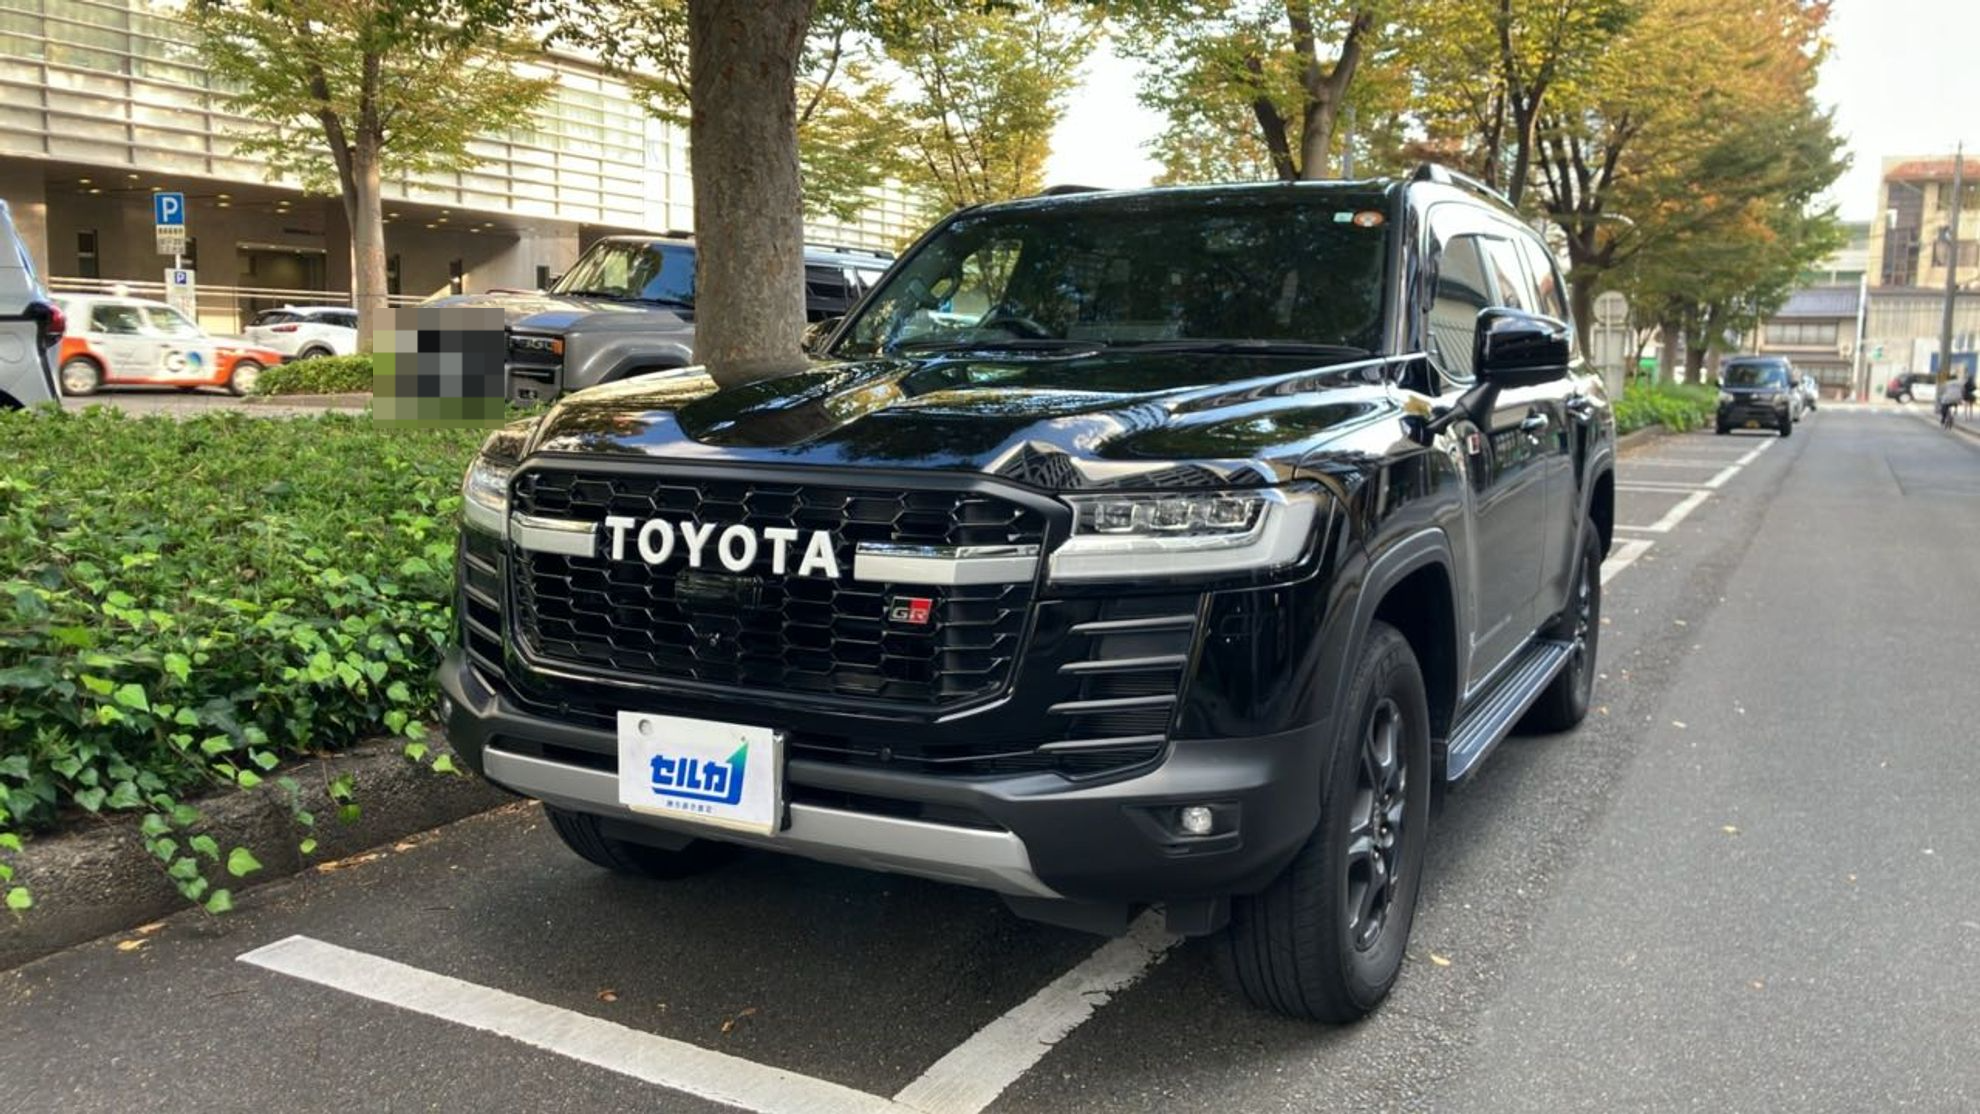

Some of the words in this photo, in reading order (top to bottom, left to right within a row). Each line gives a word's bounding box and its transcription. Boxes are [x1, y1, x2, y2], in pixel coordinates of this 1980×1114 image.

[162, 197, 179, 222] P
[605, 515, 840, 578] TOYOTA
[892, 606, 929, 621] GR
[650, 754, 729, 794] セルカ
